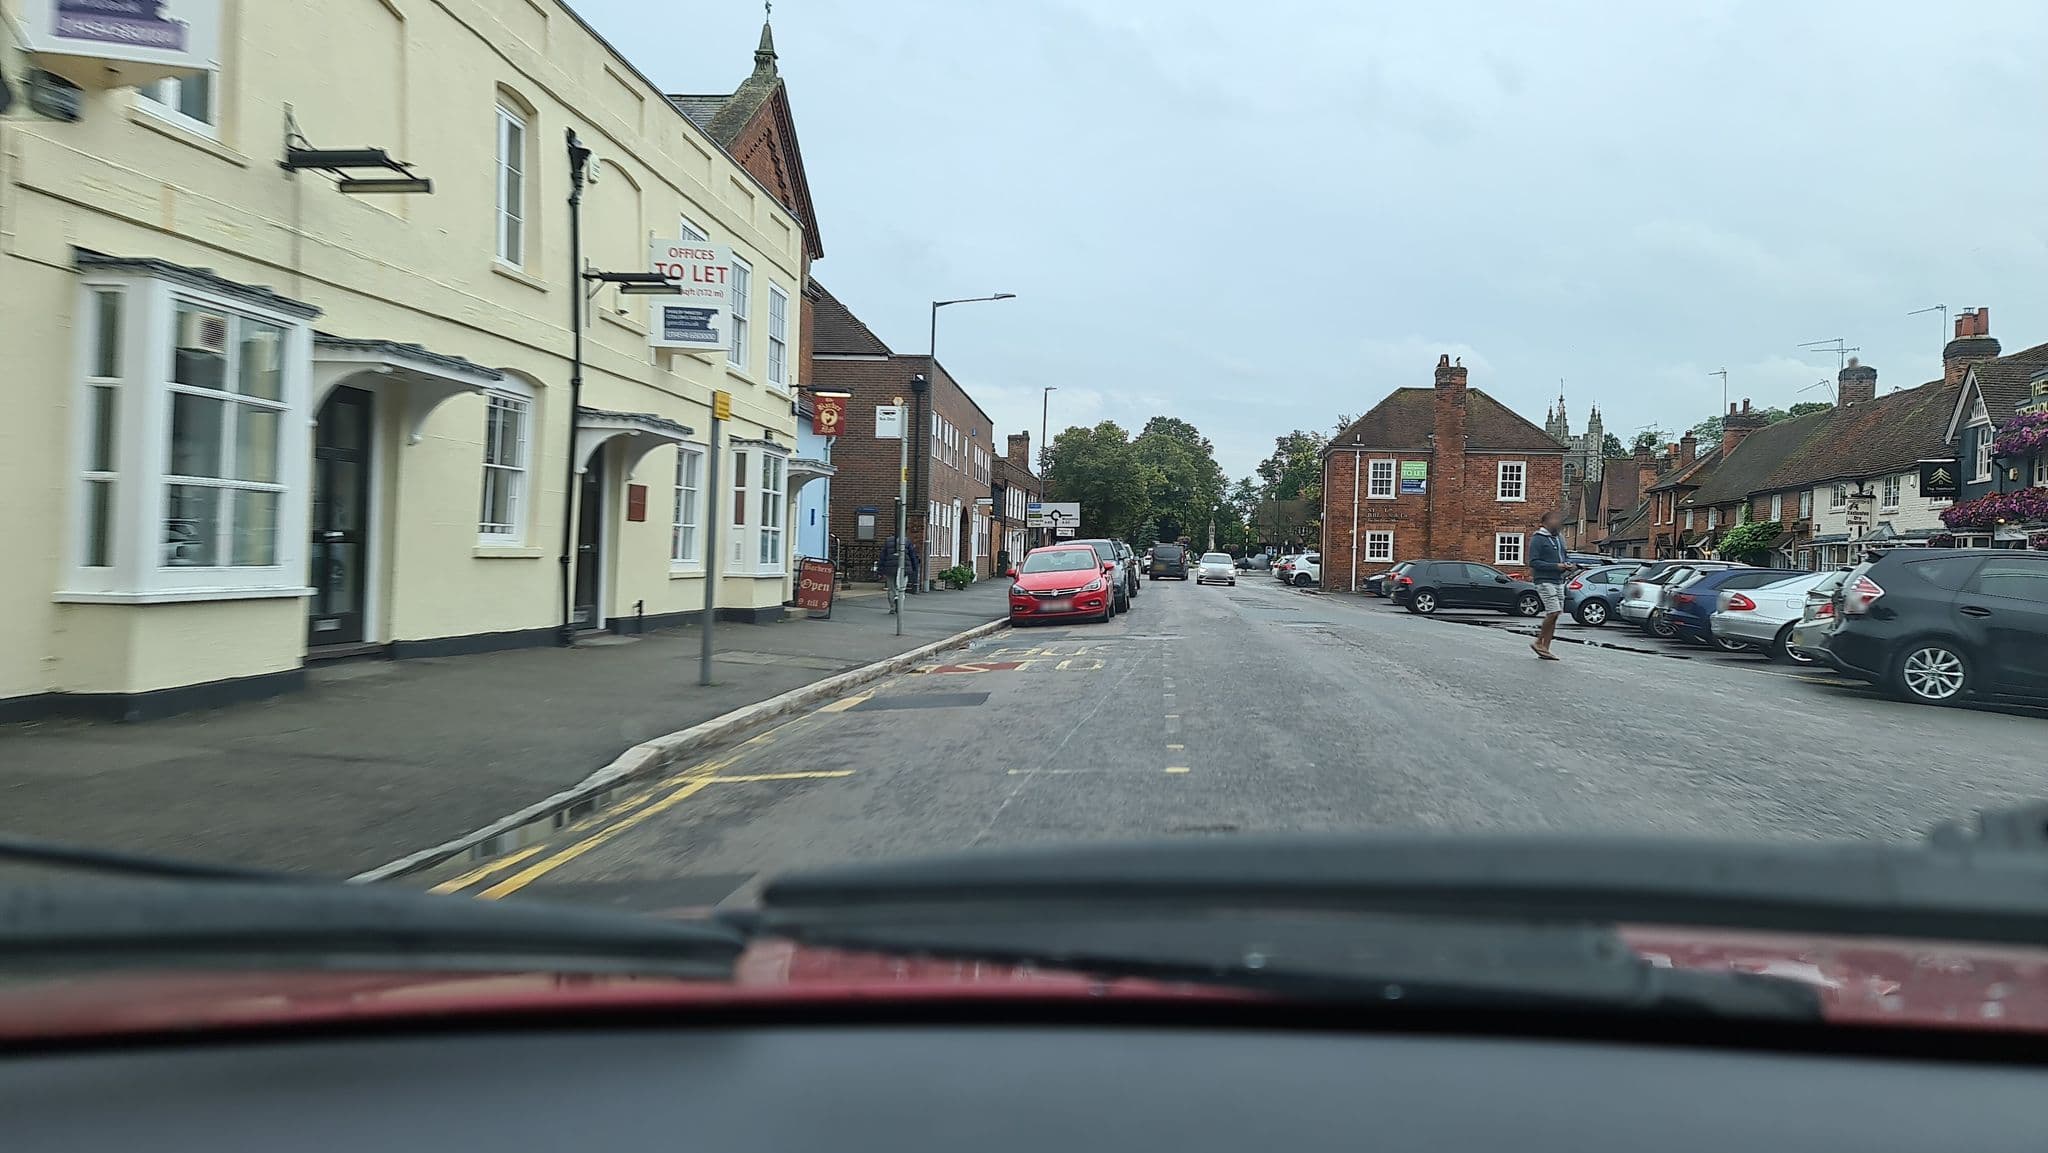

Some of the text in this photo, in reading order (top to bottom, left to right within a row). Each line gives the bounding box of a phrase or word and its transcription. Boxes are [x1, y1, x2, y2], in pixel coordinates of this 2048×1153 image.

[669, 247, 715, 260] OFFICES
[654, 263, 728, 283] TO LET
[2030, 379, 2048, 397] THE
[801, 579, 829, 592] Open
